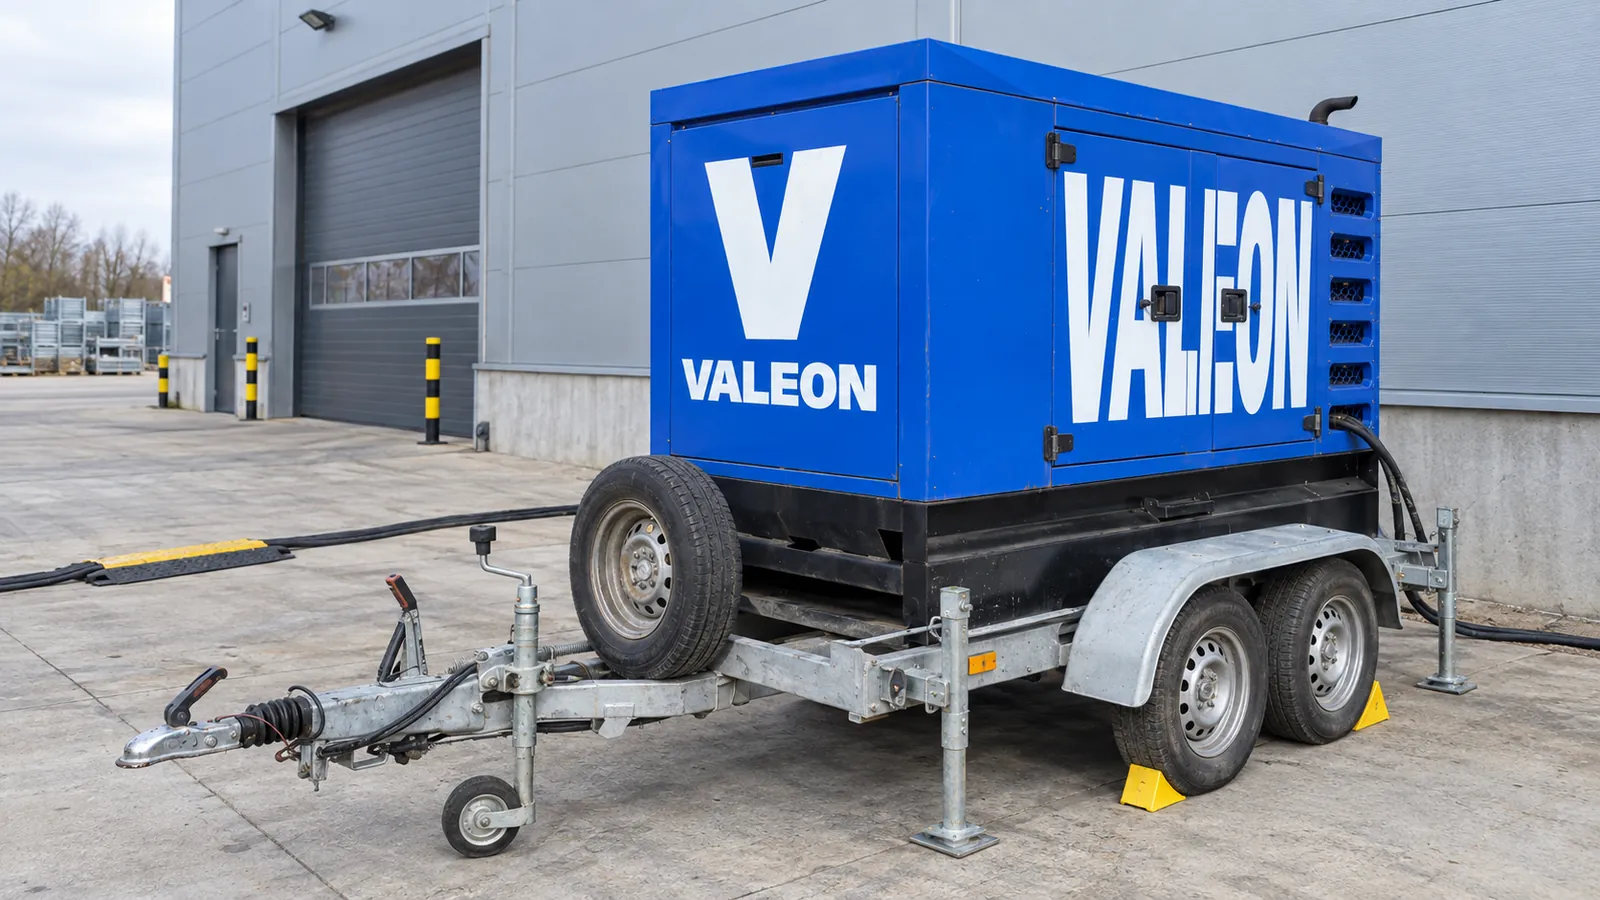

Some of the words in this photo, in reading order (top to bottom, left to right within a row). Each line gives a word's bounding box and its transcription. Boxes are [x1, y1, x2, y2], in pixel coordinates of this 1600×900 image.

[704, 145, 847, 340] V
[1064, 171, 1313, 423] VALEON
[682, 358, 877, 412] VALEON
